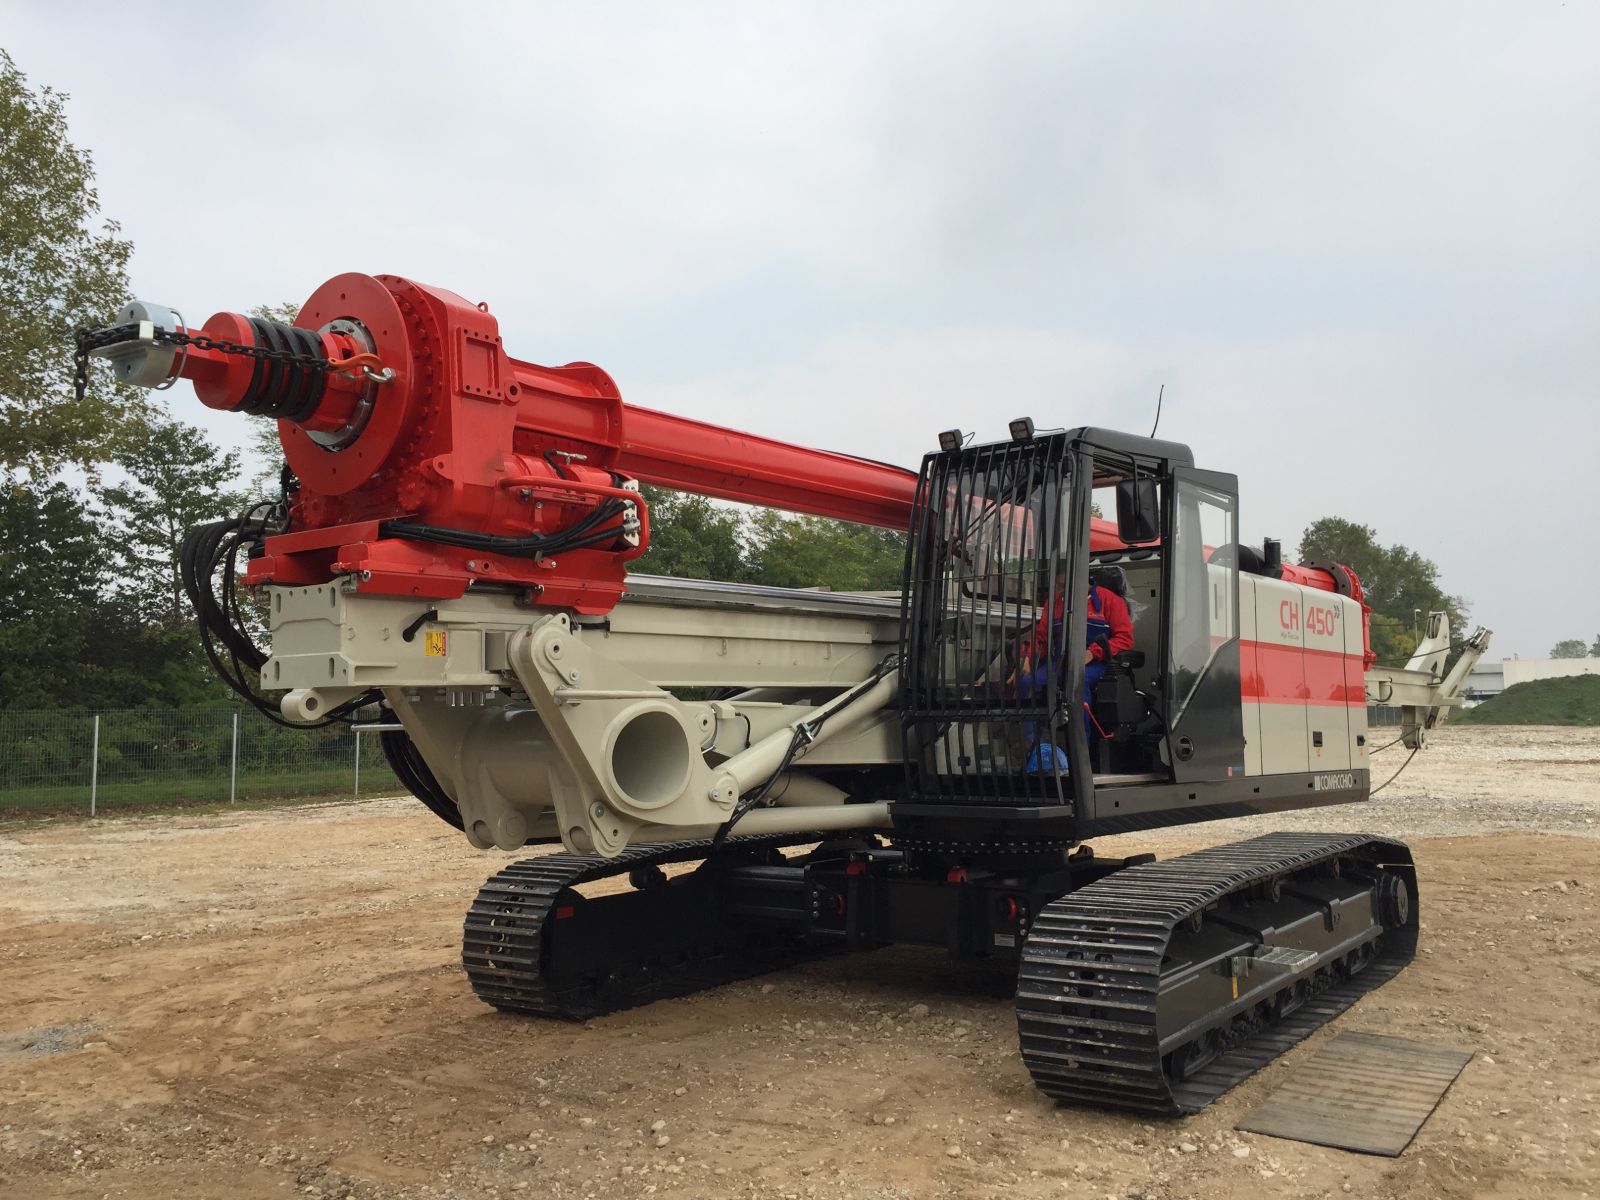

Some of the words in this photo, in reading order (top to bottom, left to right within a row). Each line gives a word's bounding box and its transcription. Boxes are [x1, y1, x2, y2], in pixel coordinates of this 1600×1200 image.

[1280, 600, 1299, 631] CH
[1306, 606, 1335, 636] 450
[1320, 773, 1353, 790] COMACCHIO
